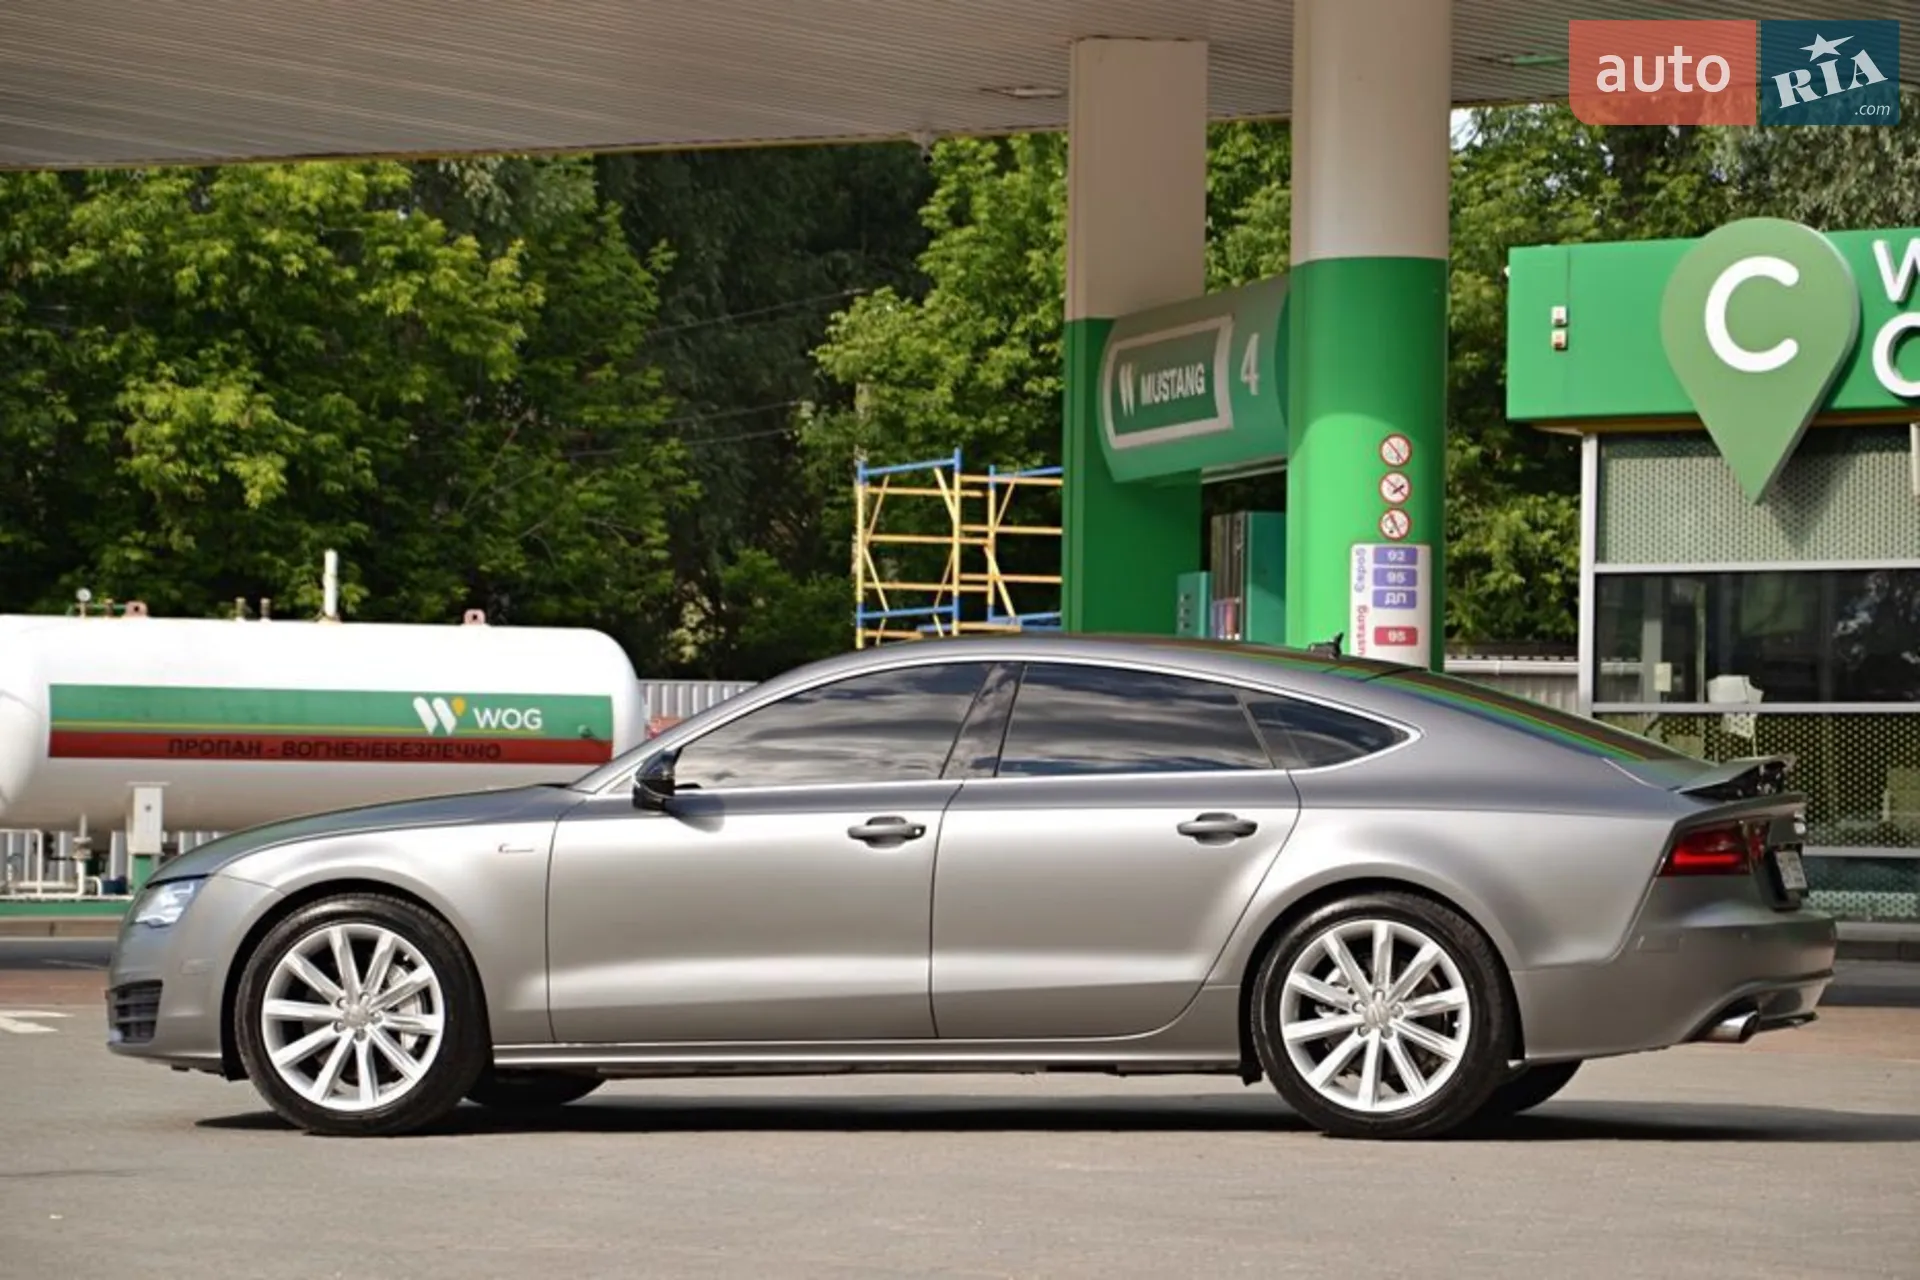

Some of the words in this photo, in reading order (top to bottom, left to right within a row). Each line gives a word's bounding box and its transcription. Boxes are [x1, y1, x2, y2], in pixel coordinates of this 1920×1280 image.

[1705, 256, 1799, 372] C
[1141, 362, 1205, 406] MUSTANG
[1241, 333, 1260, 396] 4
[1357, 604, 1369, 656] ustang
[473, 708, 543, 730] WOG
[168, 738, 262, 754] ПРОПАН
[281, 740, 502, 759] ВОГНЕНЕБЕЗПЕЧНО
